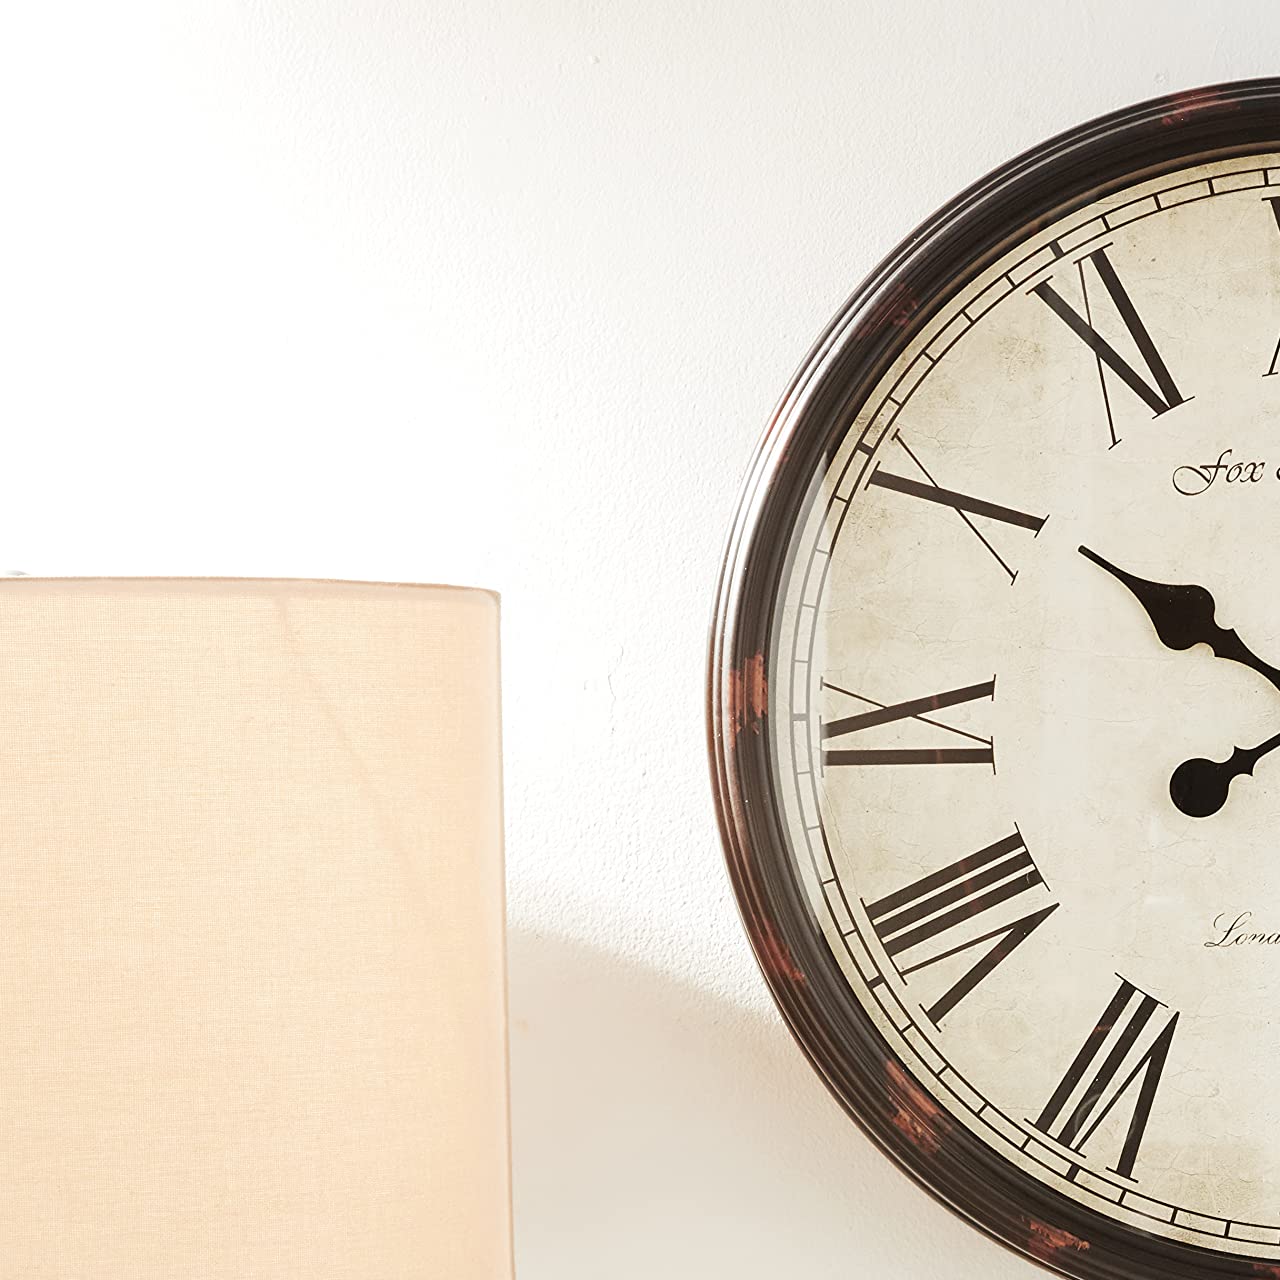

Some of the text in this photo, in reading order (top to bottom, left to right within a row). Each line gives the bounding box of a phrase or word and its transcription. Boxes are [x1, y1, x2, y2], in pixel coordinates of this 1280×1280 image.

[1025, 241, 1196, 451] XI
[863, 427, 1050, 586] X
[1171, 448, 1267, 496] Fox
